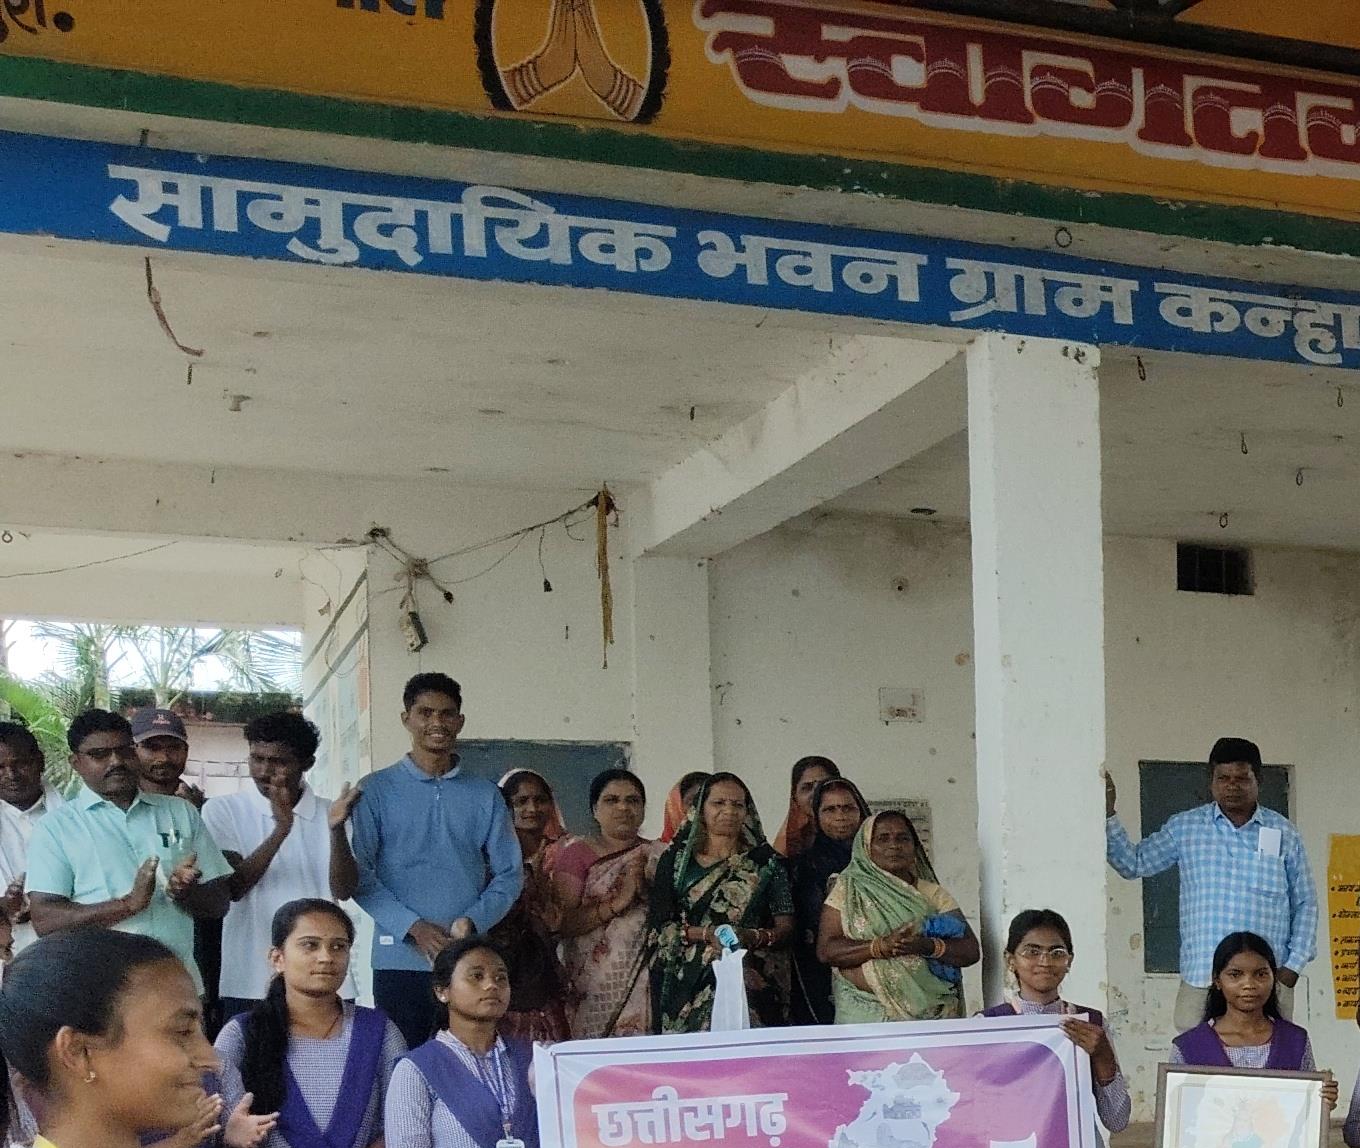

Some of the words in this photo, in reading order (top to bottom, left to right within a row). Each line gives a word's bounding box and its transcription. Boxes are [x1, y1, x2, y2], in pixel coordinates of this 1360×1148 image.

[108, 164, 677, 267] सामुदायिक
[697, 229, 928, 302] भवन
[946, 257, 1140, 325] ग्राम
[592, 1086, 789, 1148] छत्तीसगढ़
